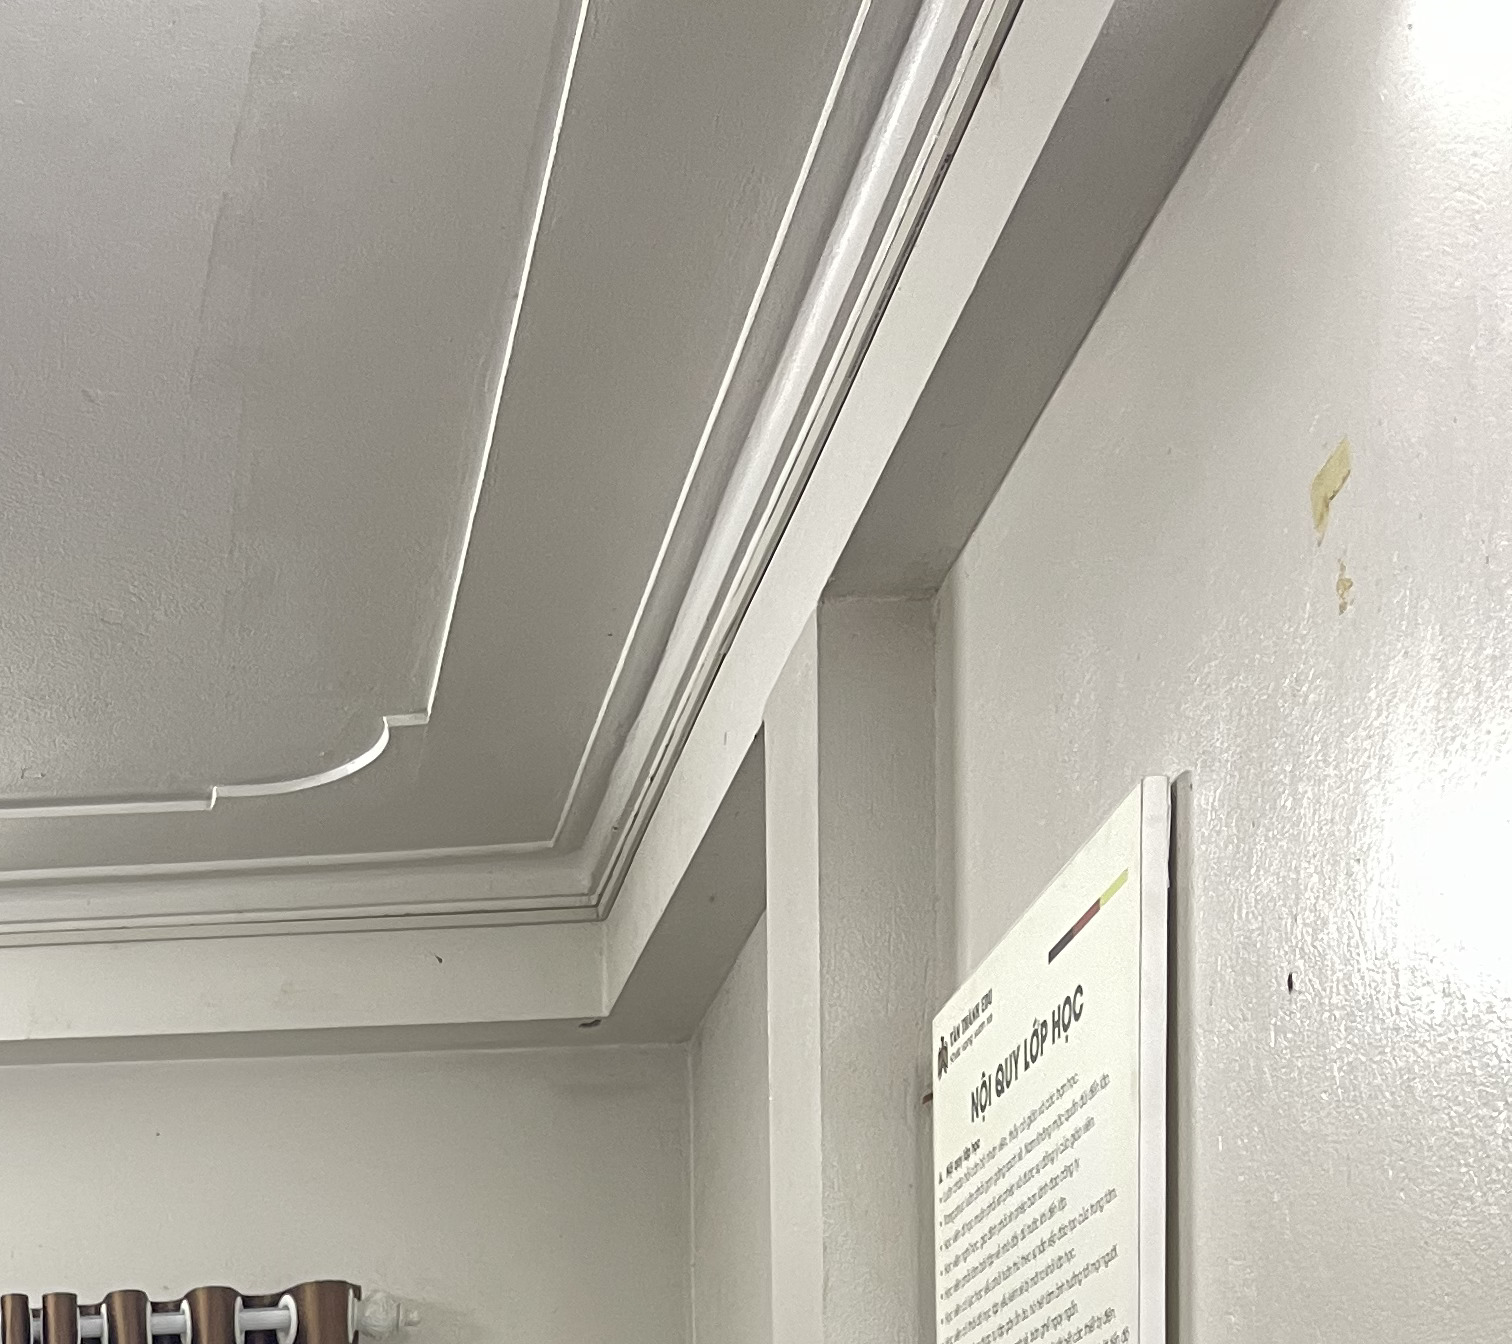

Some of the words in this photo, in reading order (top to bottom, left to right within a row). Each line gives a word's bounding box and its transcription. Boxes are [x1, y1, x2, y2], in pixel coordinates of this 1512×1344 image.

[971, 1071, 992, 1123] NỘI
[995, 1044, 1021, 1098] QUY
[1023, 1017, 1048, 1072] LỚP
[1051, 984, 1084, 1044] HỌC
